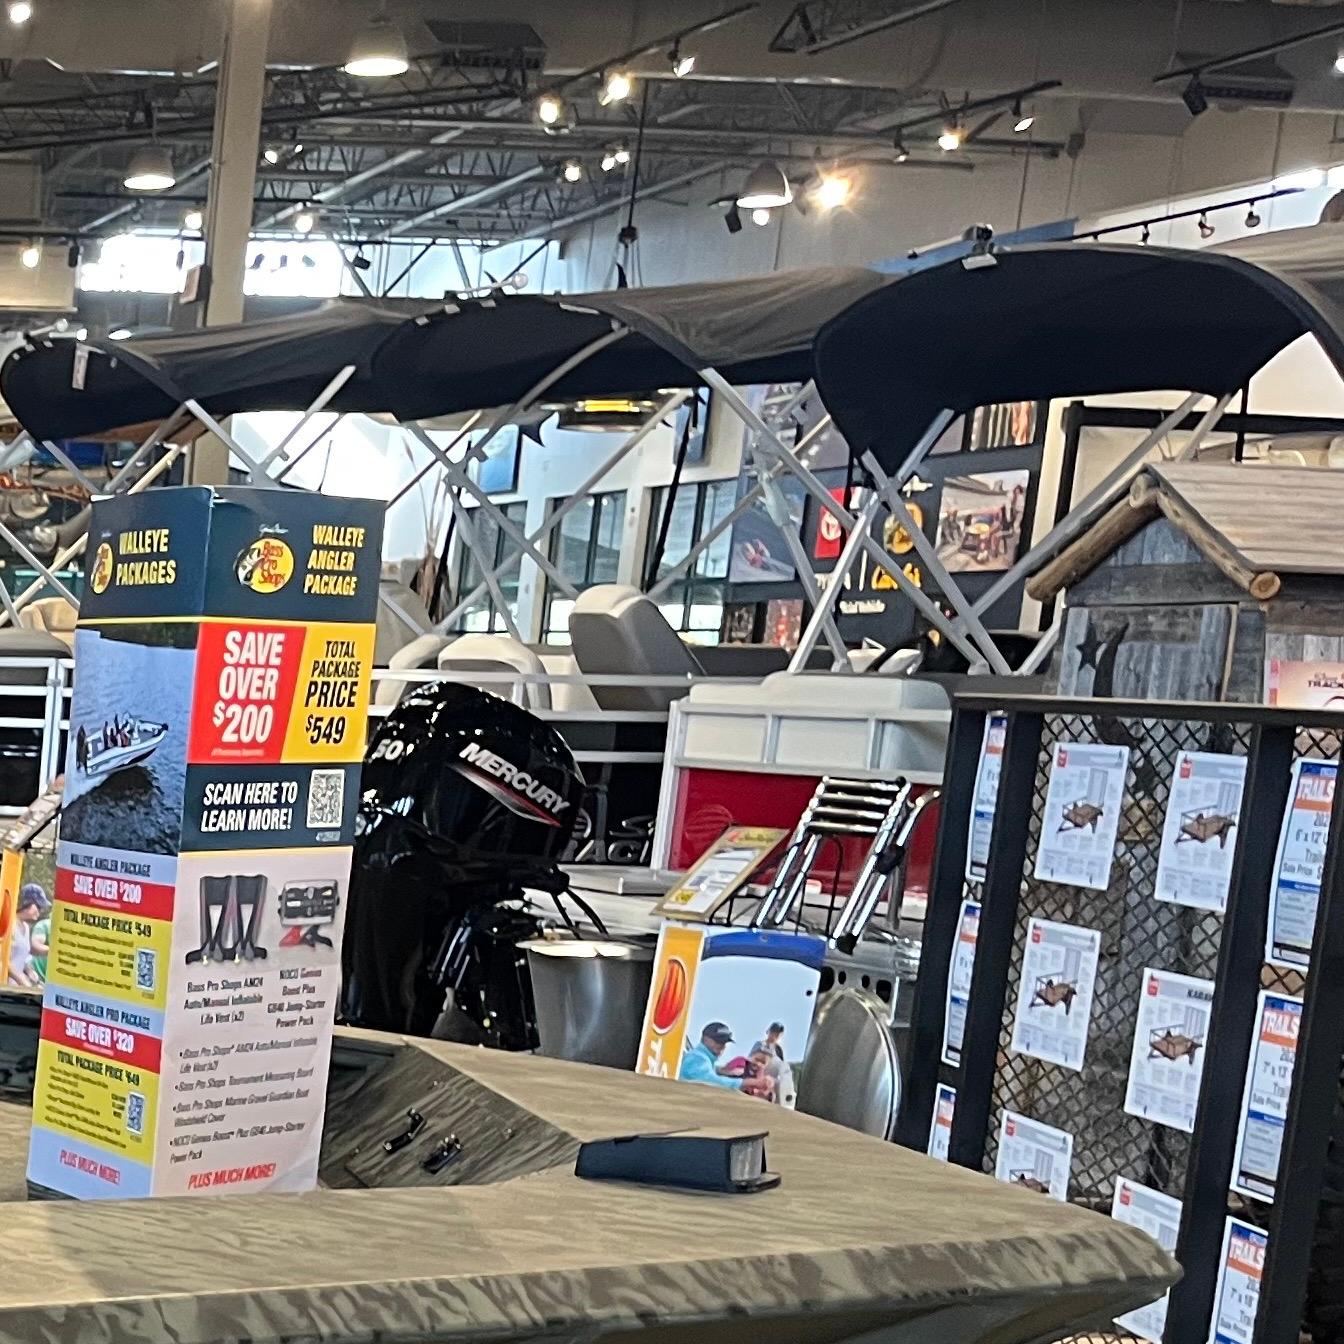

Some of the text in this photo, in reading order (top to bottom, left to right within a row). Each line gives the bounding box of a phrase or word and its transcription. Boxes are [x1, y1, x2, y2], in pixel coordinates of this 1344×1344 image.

[118, 528, 169, 555] WALLEYE
[312, 524, 365, 548] WALLEYE
[116, 560, 176, 586] PACKAGES
[307, 549, 355, 572] ANGLER
[303, 574, 357, 597] PACKAGE
[223, 631, 286, 665] SAVE
[325, 641, 356, 658] TOTAL
[311, 660, 361, 678] PACKAGE
[218, 666, 279, 700] OVER
[304, 681, 359, 708] PRICE
[212, 700, 274, 743] $200
[305, 714, 346, 744] $549
[458, 742, 571, 814] MERCURY
[203, 781, 298, 806] SCAN HERE TO
[200, 808, 292, 832] LEARN MORE!
[73, 874, 93, 896] SAVE
[94, 877, 118, 900] OVER
[65, 1017, 86, 1041] SAVE
[88, 1022, 111, 1047] OVER
[188, 1163, 276, 1190] PLUS MUCH MORE!
